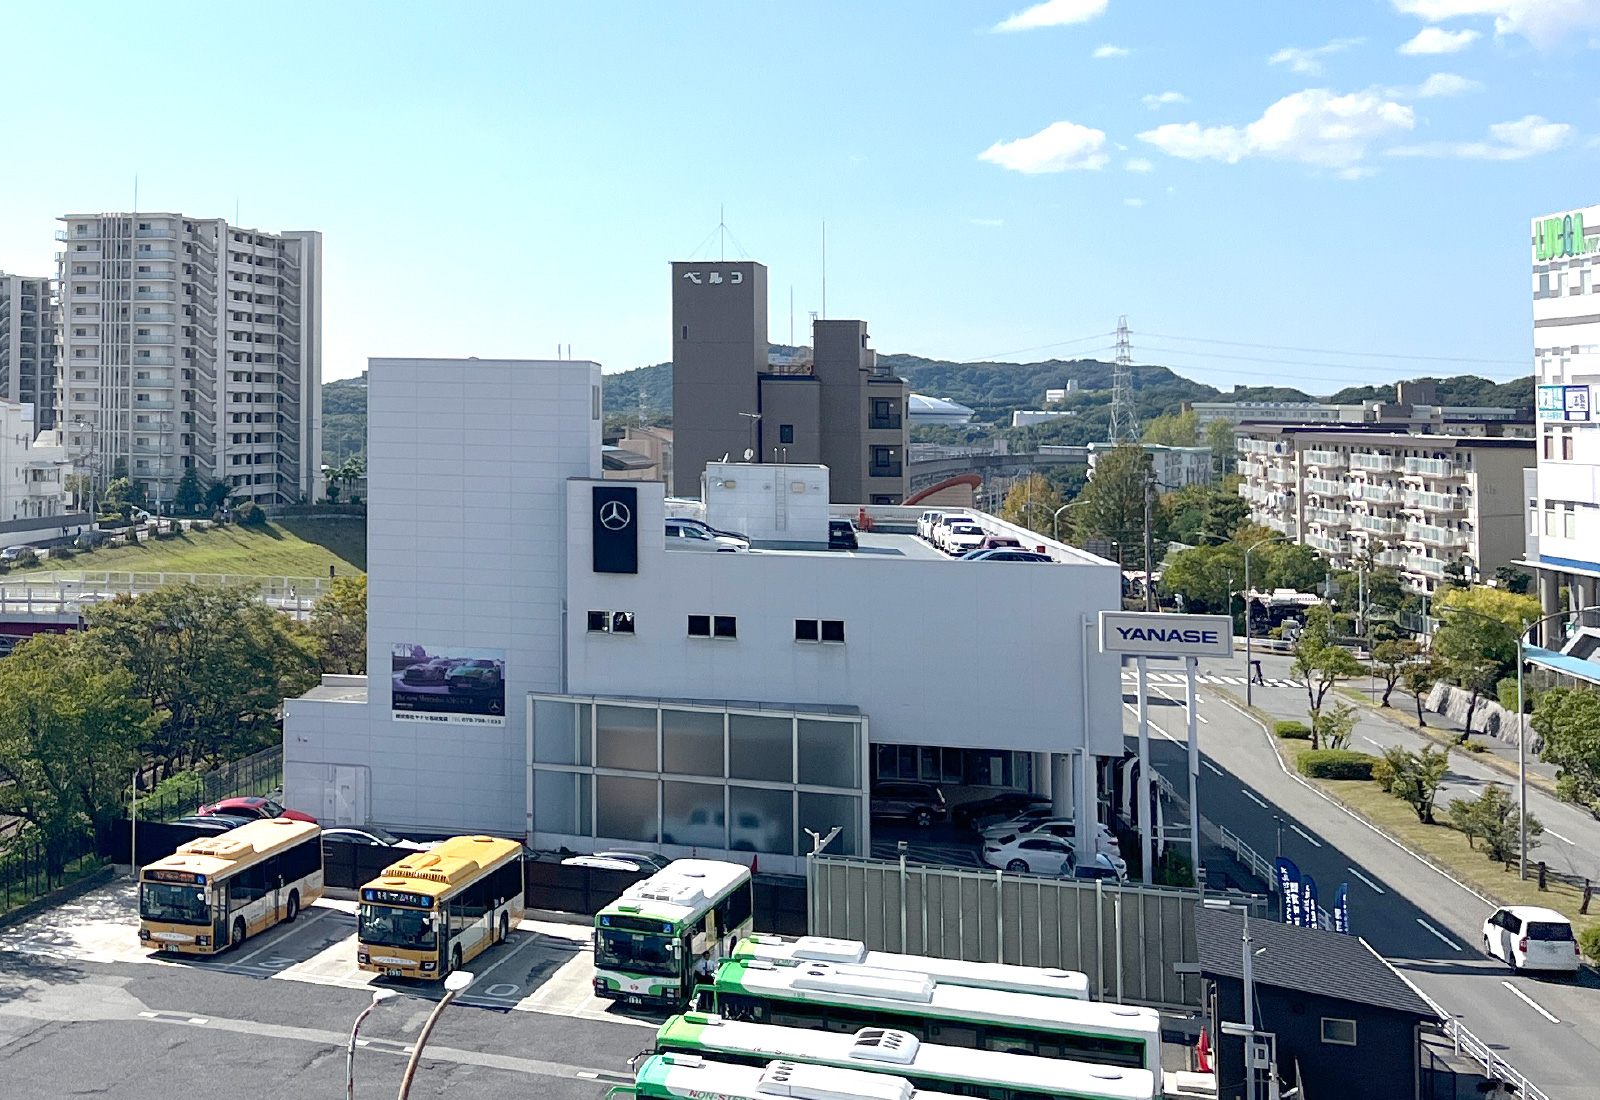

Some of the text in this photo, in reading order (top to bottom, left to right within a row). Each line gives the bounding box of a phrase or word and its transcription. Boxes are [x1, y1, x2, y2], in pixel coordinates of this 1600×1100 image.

[683, 271, 744, 284] ベルコ
[1116, 627, 1219, 644] YANASE
